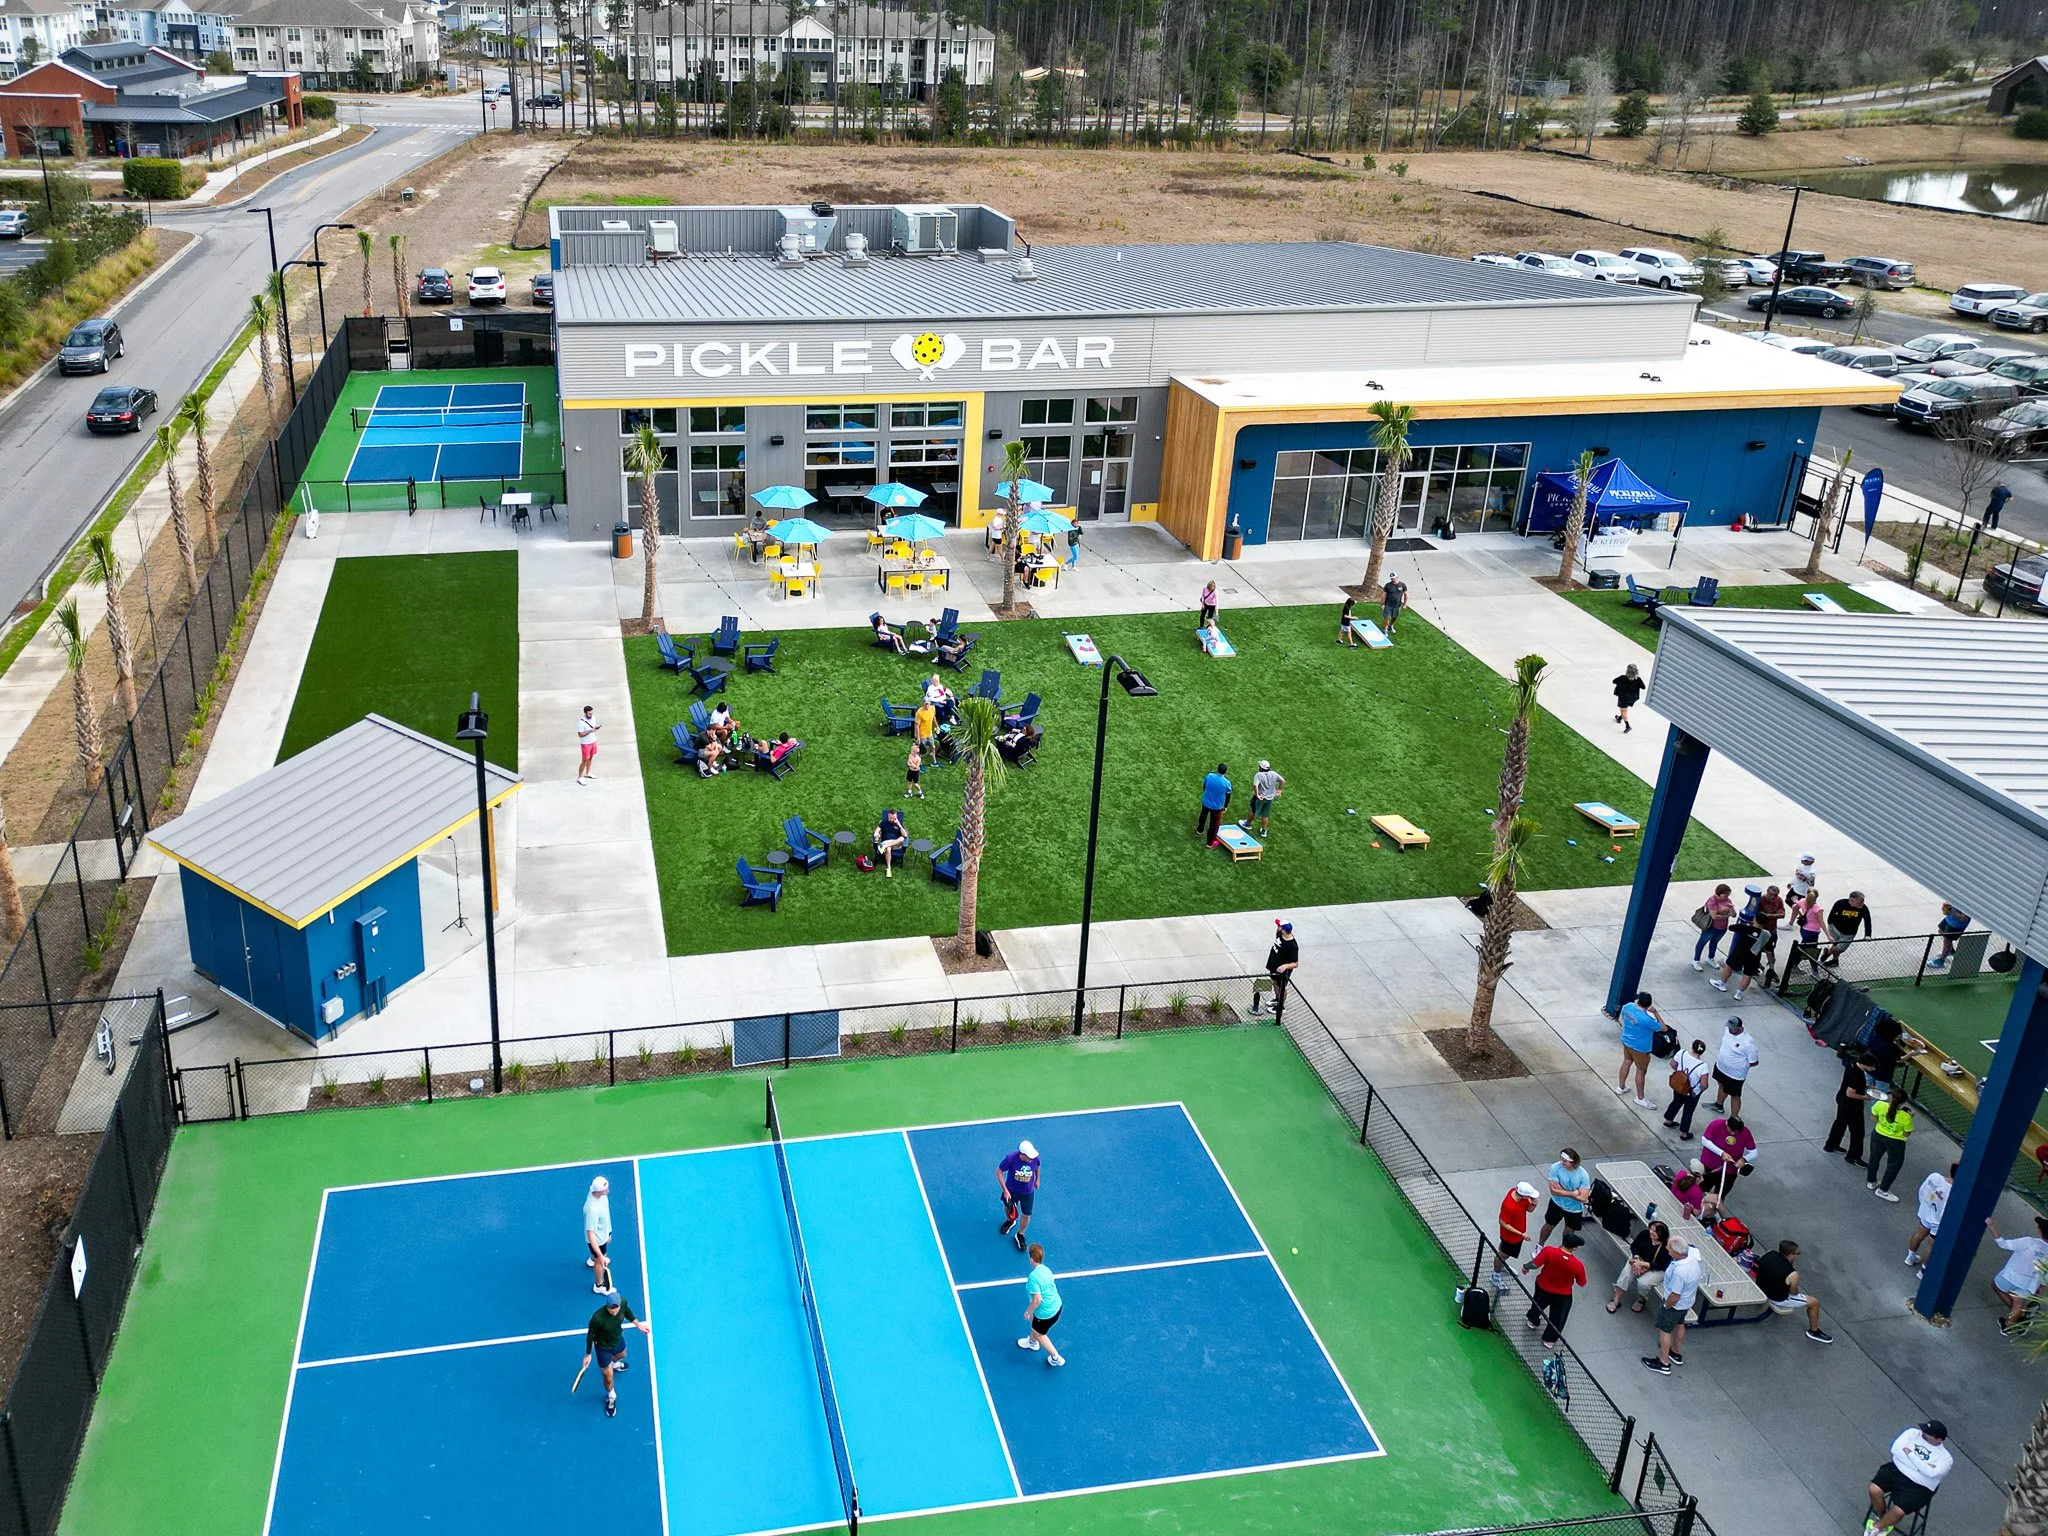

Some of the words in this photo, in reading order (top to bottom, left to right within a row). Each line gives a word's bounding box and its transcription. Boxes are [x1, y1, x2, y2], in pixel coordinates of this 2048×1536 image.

[625, 341, 872, 377] PICKLE
[981, 336, 1115, 370] BAR
[1609, 489, 1657, 498] PICKLEBALL
